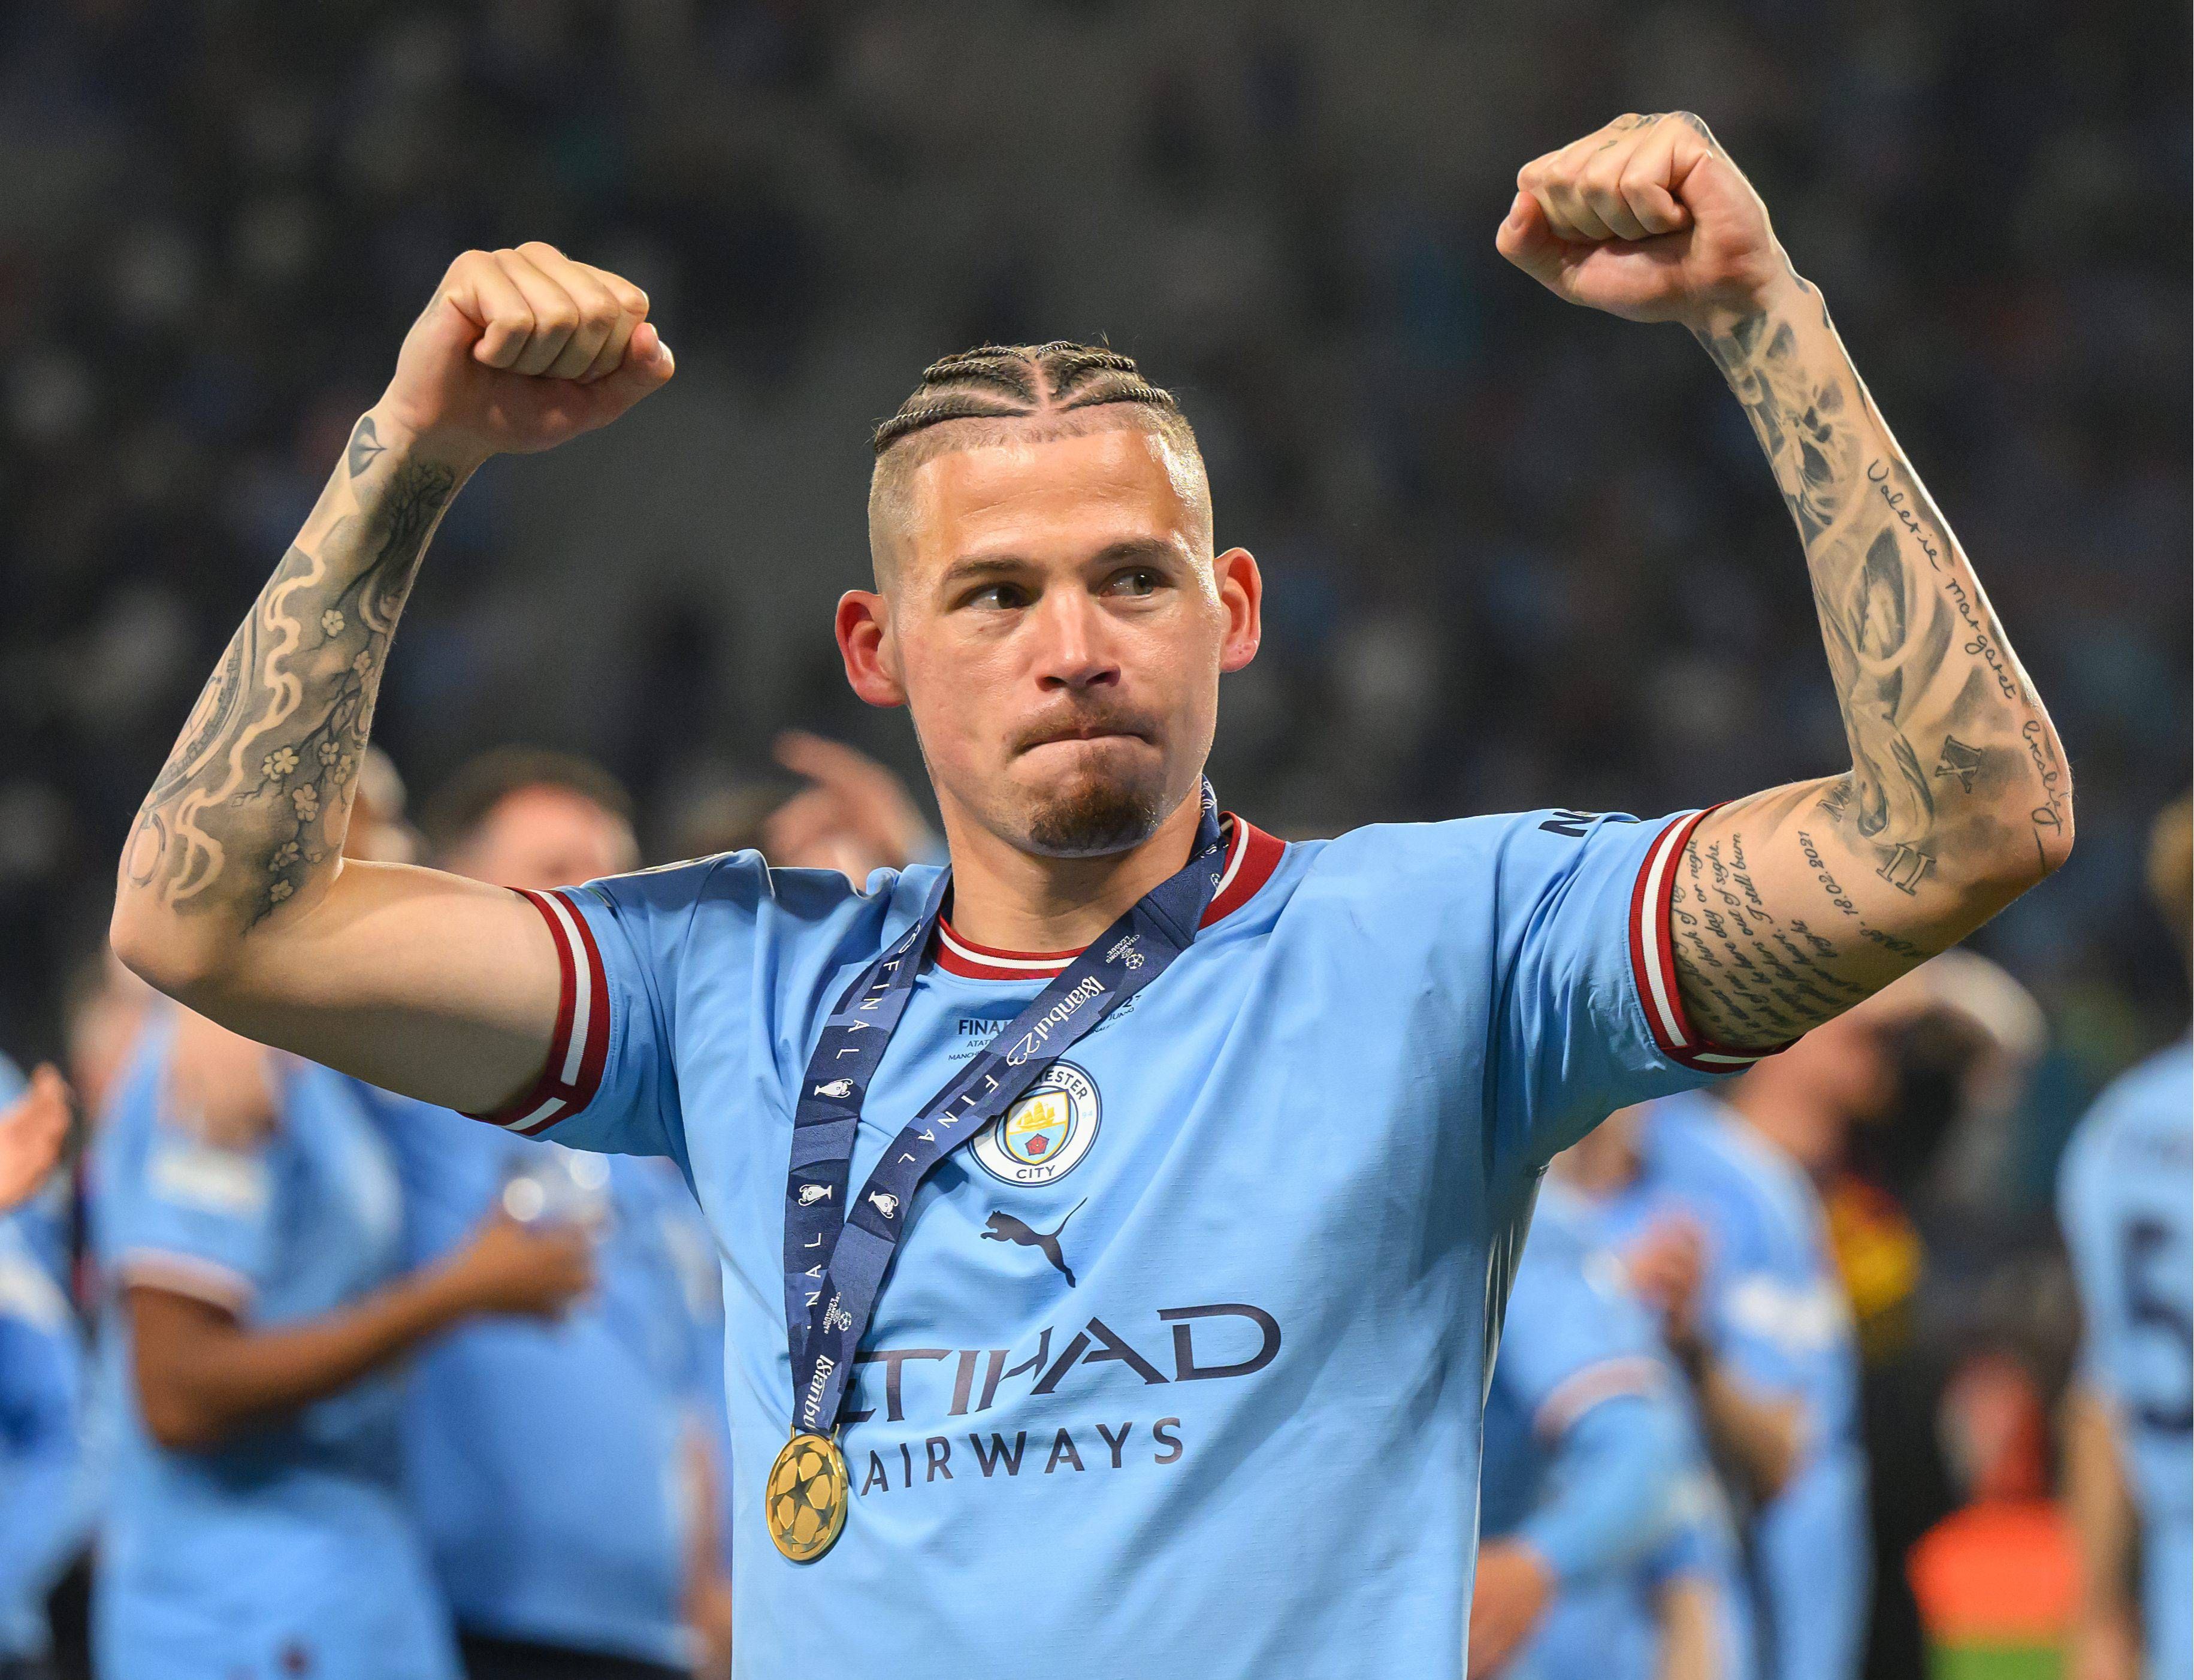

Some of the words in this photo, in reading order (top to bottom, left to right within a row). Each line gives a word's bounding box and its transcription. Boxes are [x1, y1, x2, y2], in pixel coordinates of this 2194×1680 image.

[1694, 884, 1707, 902] or
[1105, 934, 1140, 963] CHAMPIONS
[836, 961, 900, 1060] FINAL
[1033, 975, 1106, 1041] Istanbul
[966, 1039, 992, 1048] ATAT
[1039, 1069, 1089, 1101] ESTER
[897, 1074, 999, 1165] FINAL
[1016, 1165, 1056, 1180] CITY
[803, 1354, 835, 1431] Istanbu
[860, 1416, 1184, 1497] AIRWAYS
